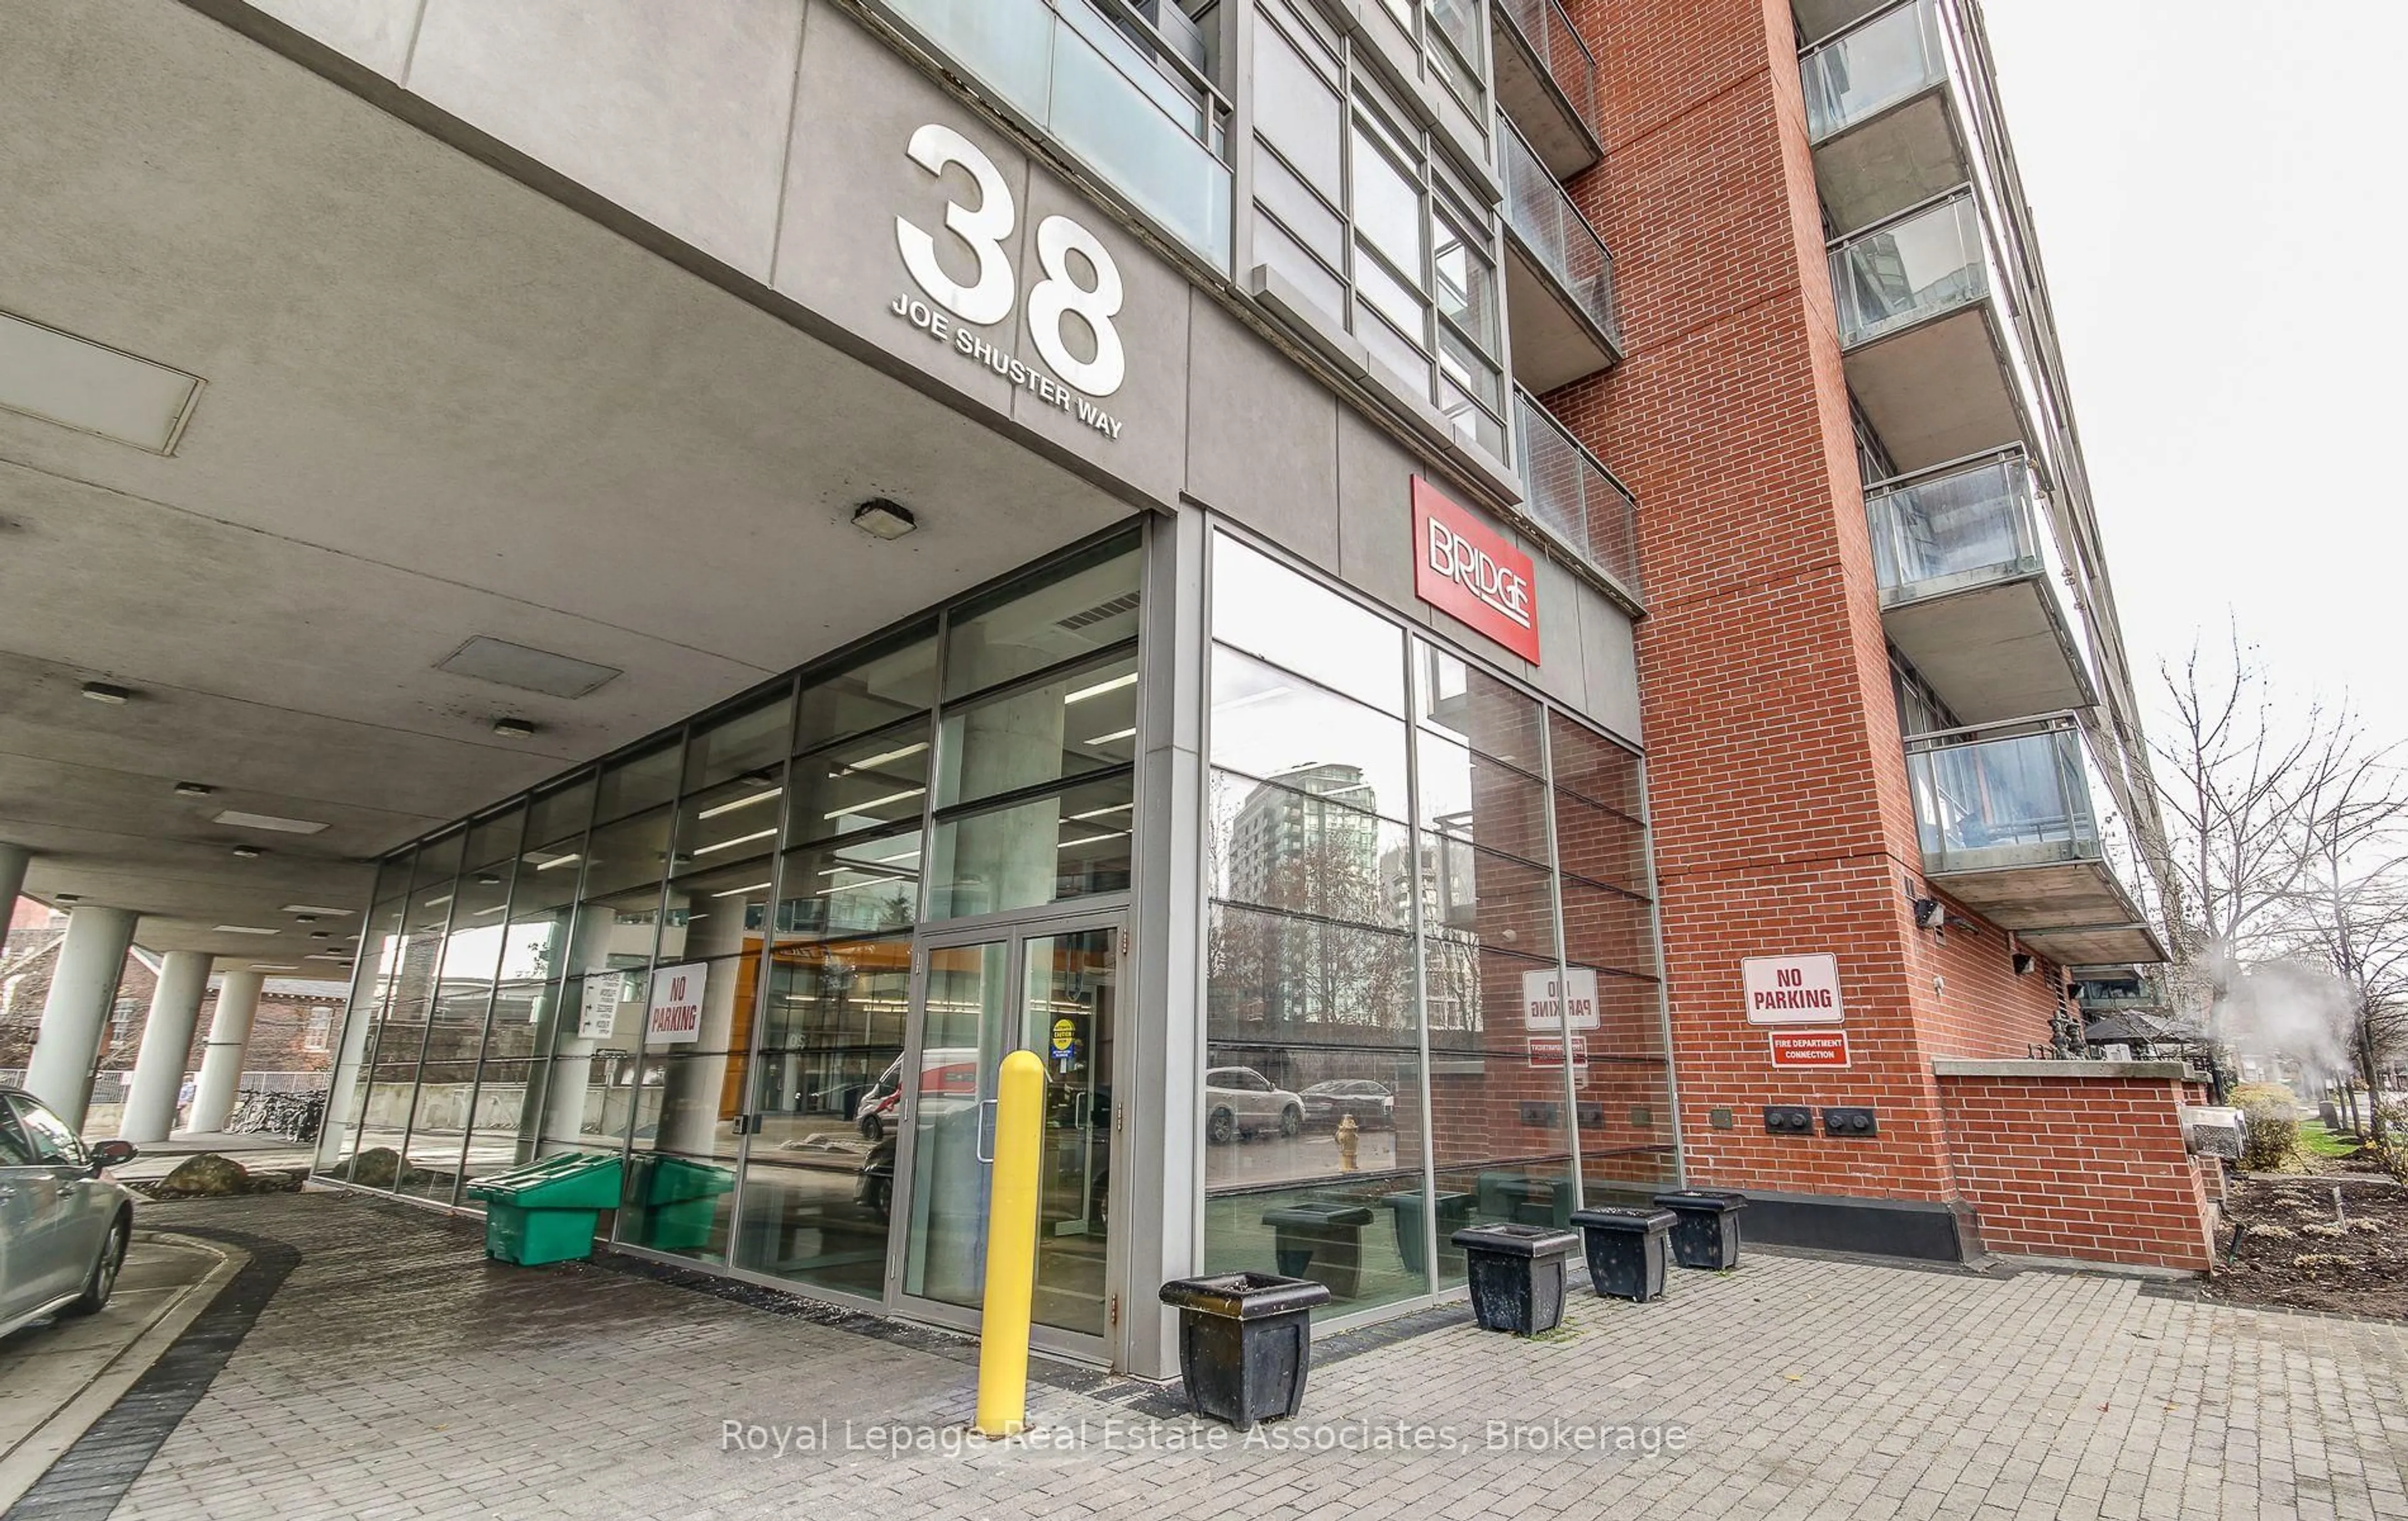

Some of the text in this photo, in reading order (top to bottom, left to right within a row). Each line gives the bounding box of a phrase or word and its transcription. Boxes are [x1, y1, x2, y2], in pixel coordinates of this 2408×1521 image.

[896, 124, 1125, 396] 38
[892, 293, 1123, 440] JOE SHUSTER WAY
[1427, 516, 1531, 628] BRIDGE
[669, 976, 687, 1002] NO
[1777, 968, 1802, 987] NO
[1754, 989, 1832, 1010] PARKING
[652, 1005, 697, 1032] PARKING
[1775, 1039, 1842, 1048] FIRE DEPARTMENT
